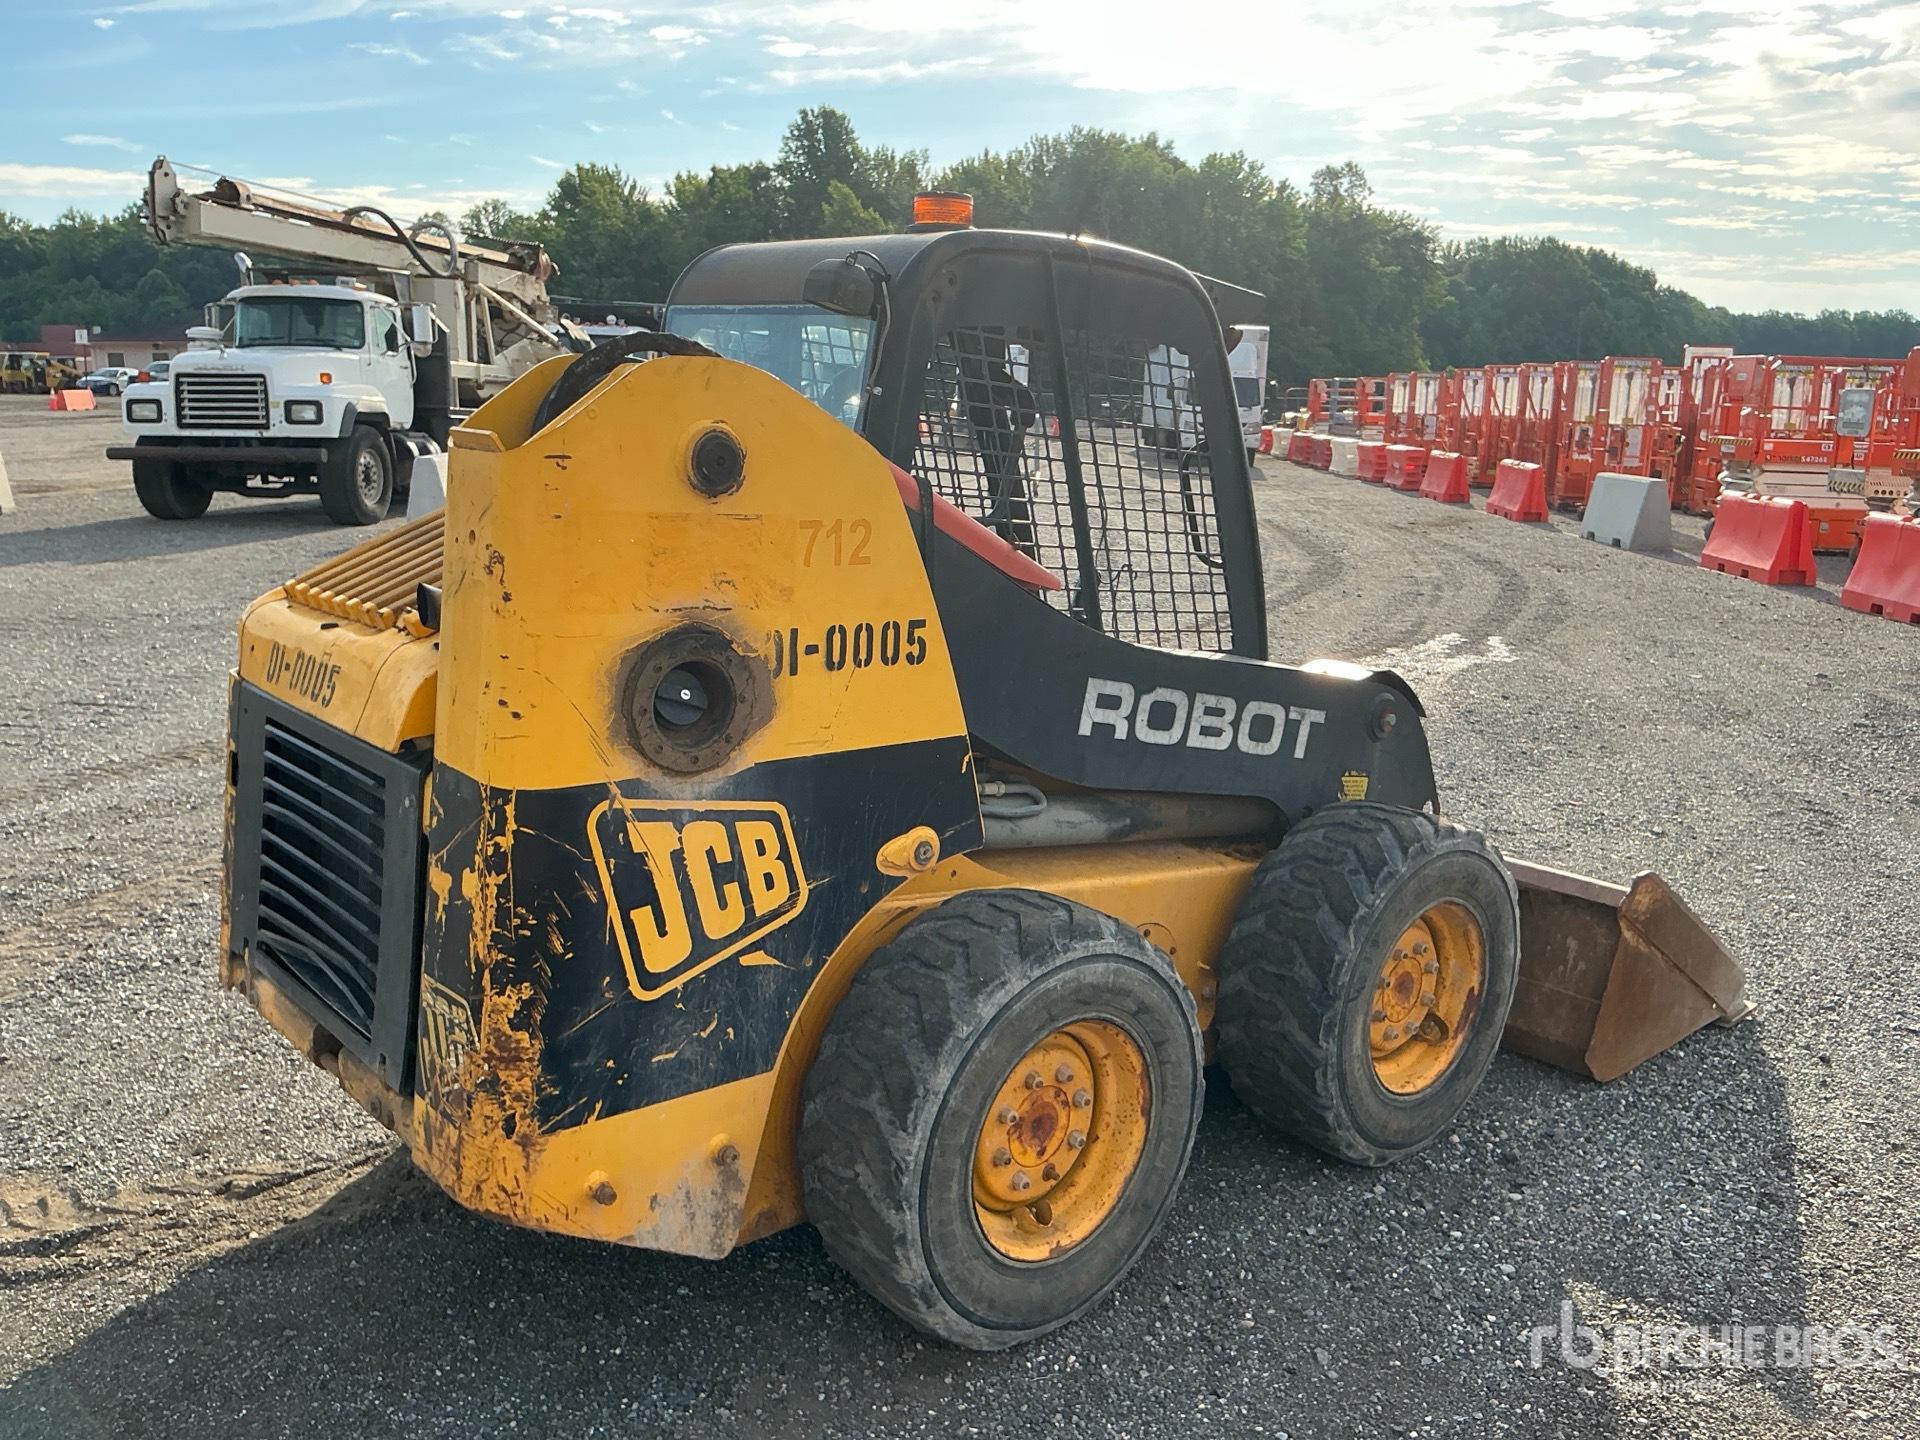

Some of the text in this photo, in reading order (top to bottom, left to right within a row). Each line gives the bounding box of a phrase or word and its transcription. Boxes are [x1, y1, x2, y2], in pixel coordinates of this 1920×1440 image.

[799, 518, 872, 568] 712
[1078, 677, 1327, 759] ROBOT
[626, 820, 790, 974] JCB
